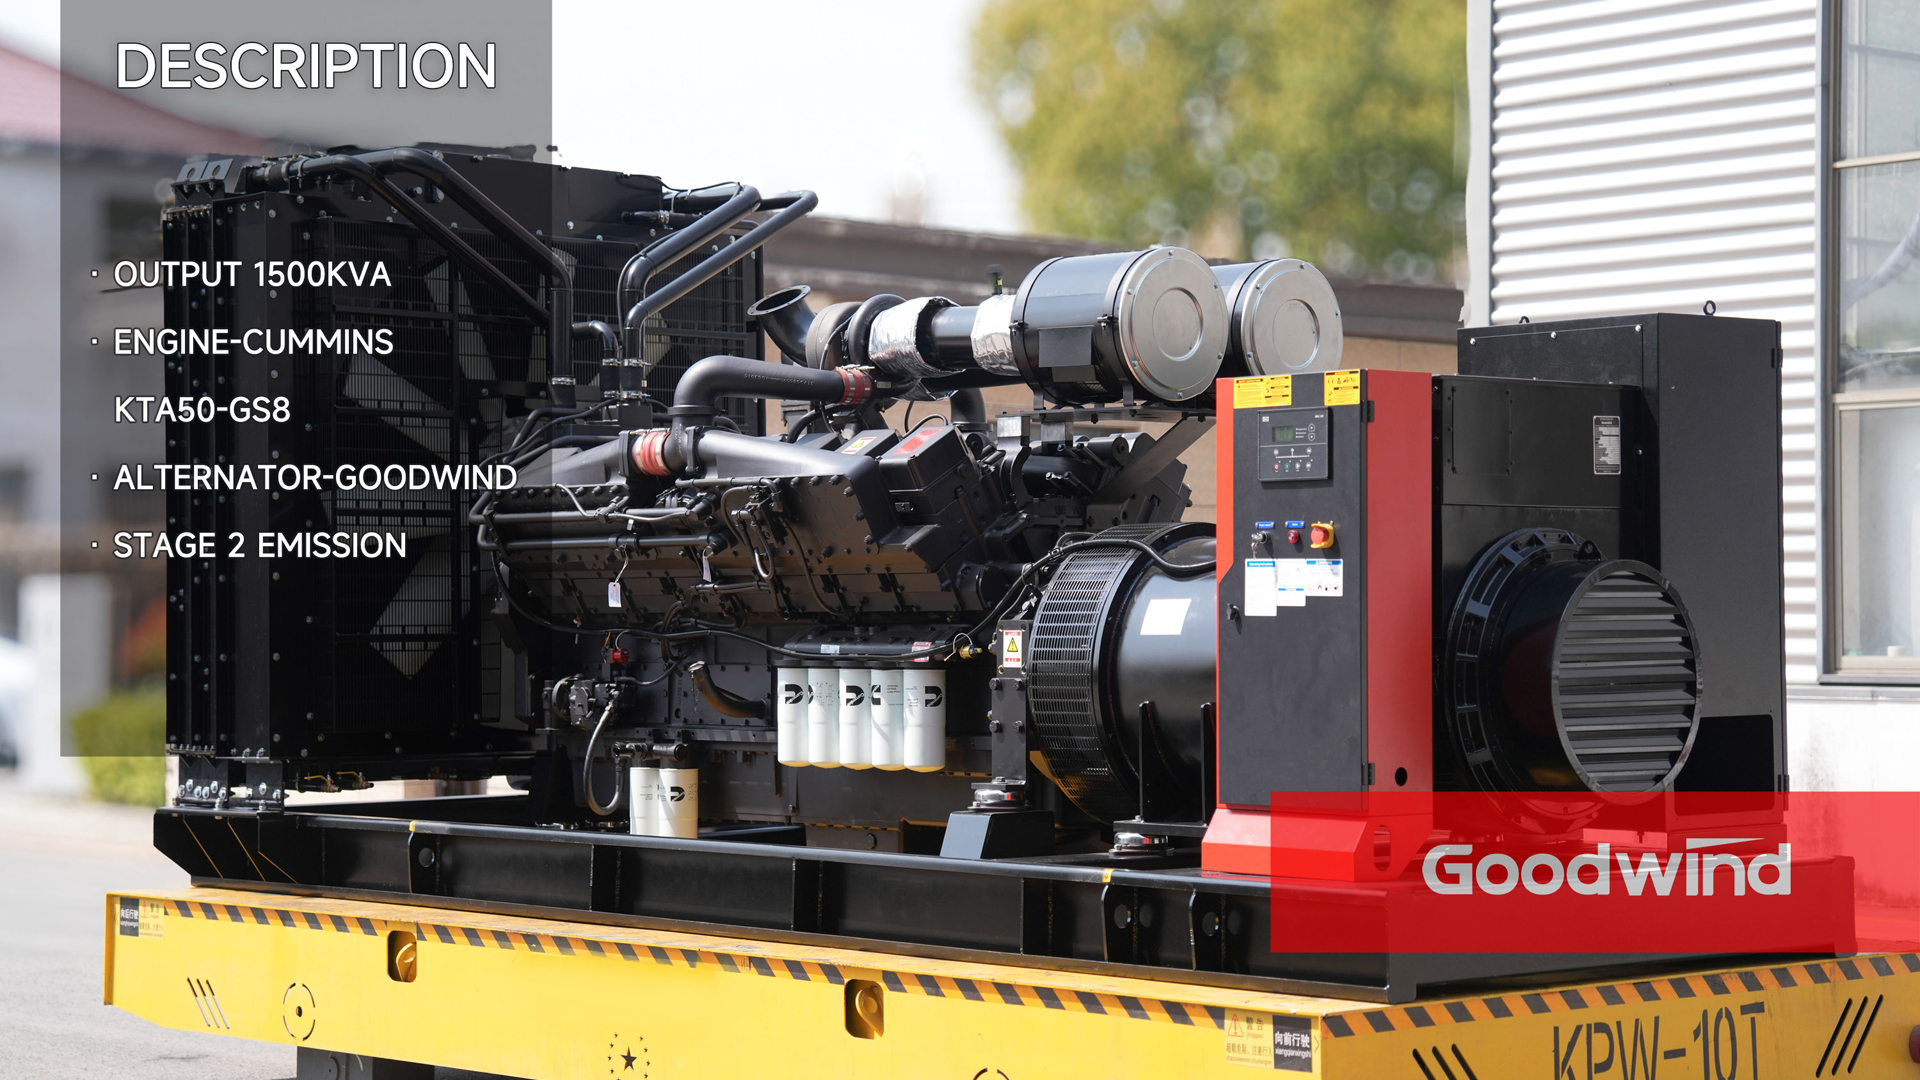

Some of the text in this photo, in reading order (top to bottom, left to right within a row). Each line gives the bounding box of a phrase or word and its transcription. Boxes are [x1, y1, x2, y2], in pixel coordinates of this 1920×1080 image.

[1274, 1031, 1310, 1048] 向前行驶
[1553, 1001, 1765, 1080] KPW-10T
